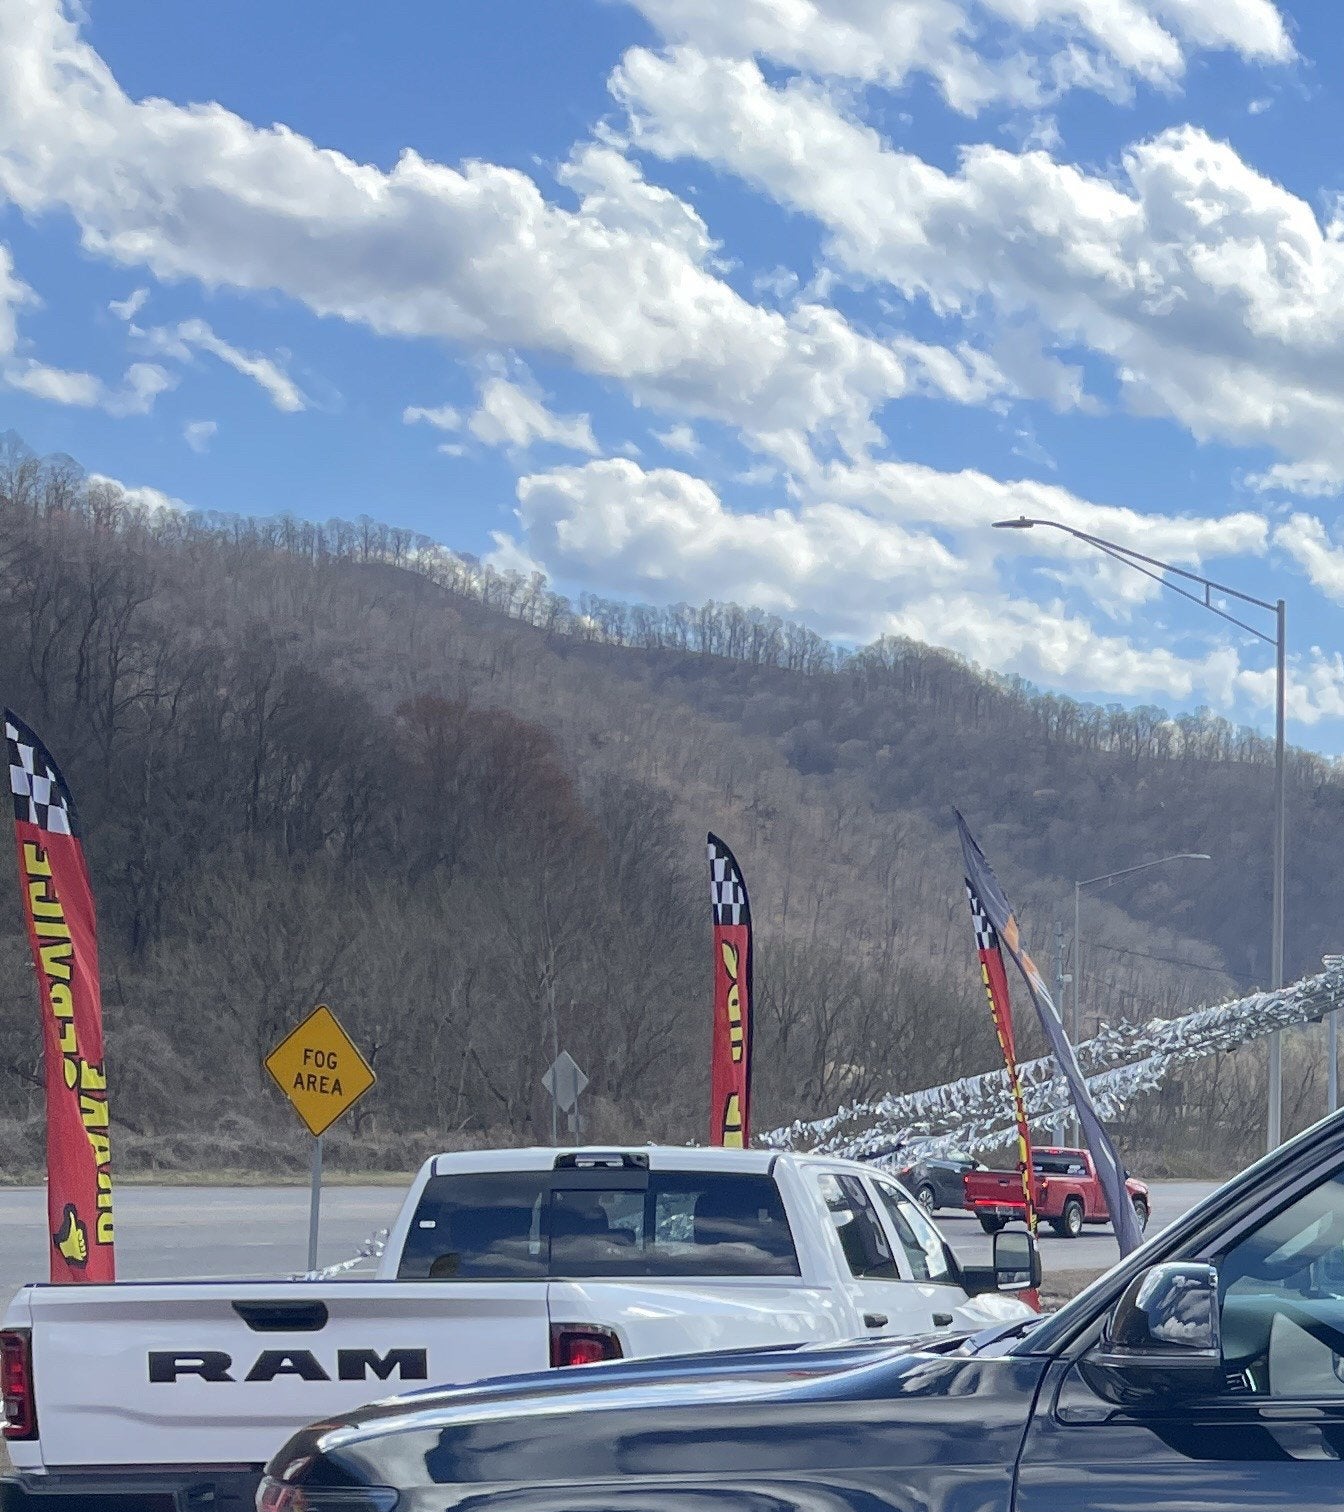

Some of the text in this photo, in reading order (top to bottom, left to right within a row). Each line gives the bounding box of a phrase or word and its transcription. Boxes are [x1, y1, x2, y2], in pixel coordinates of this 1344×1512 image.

[303, 1048, 337, 1070] FOG
[293, 1072, 342, 1096] AREA
[148, 1348, 427, 1382] RAM
